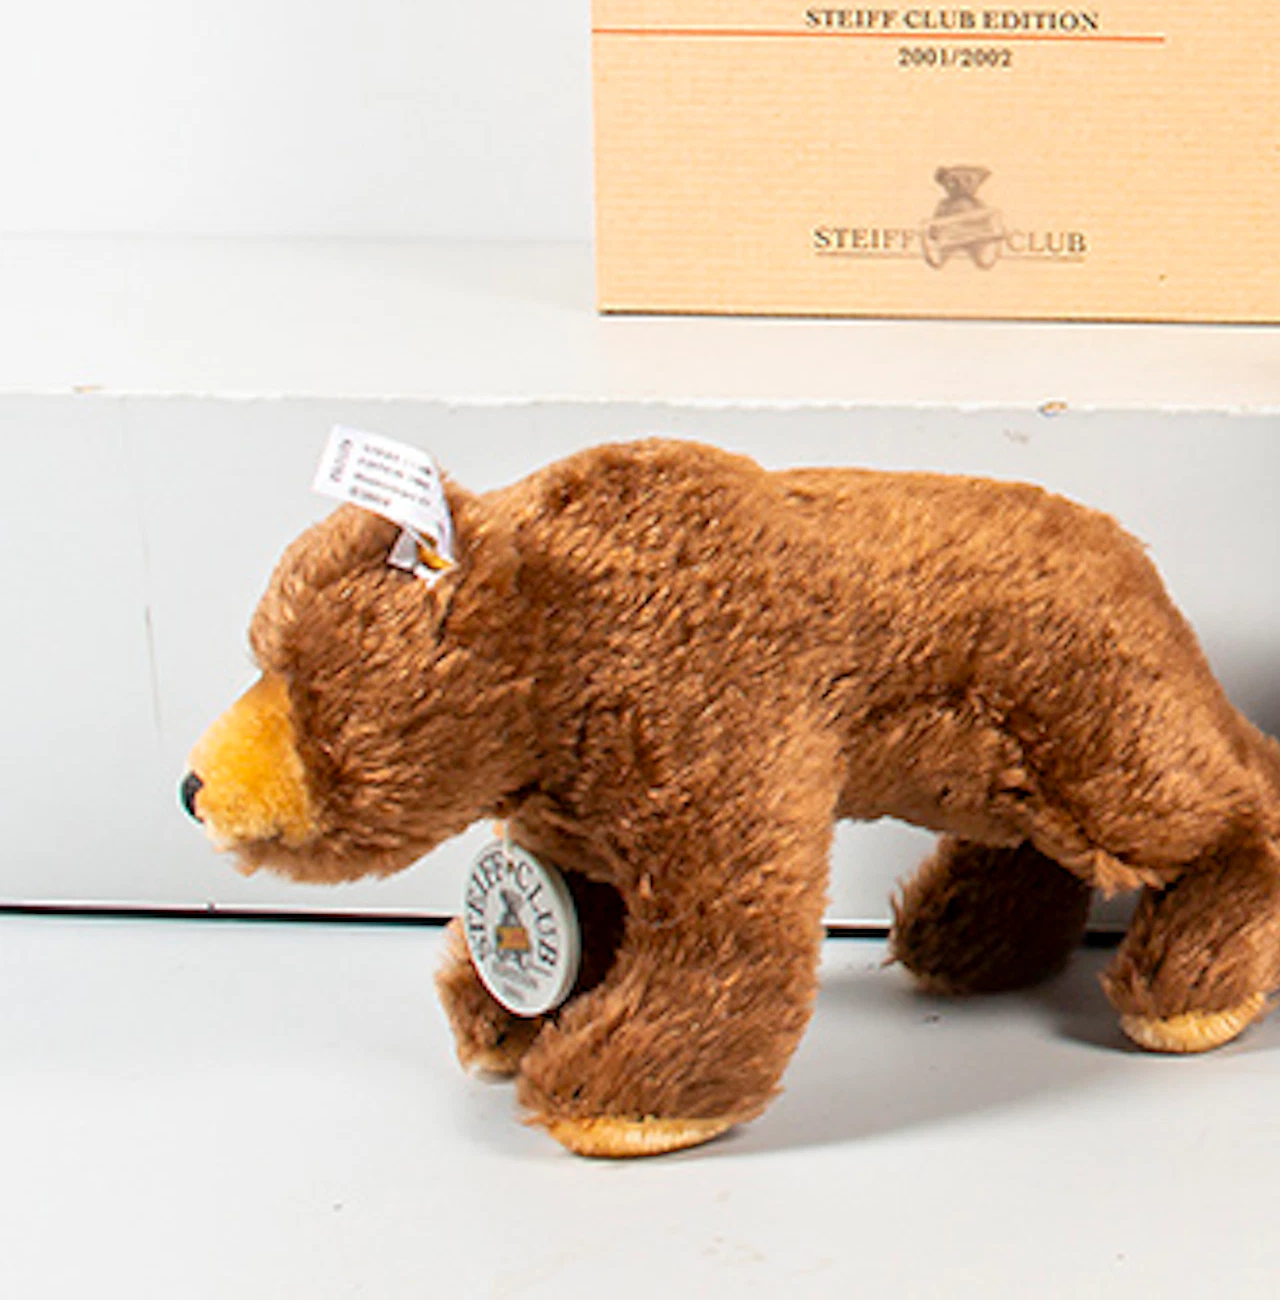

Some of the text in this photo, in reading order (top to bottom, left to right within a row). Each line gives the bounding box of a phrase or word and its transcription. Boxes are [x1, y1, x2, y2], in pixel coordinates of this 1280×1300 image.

[805, 9, 1099, 31] STEIFF CLUB EDITION
[898, 46, 1013, 67] 2001/2002
[813, 226, 1087, 254] STEIFF CLUB
[515, 861, 558, 967] CLUB
